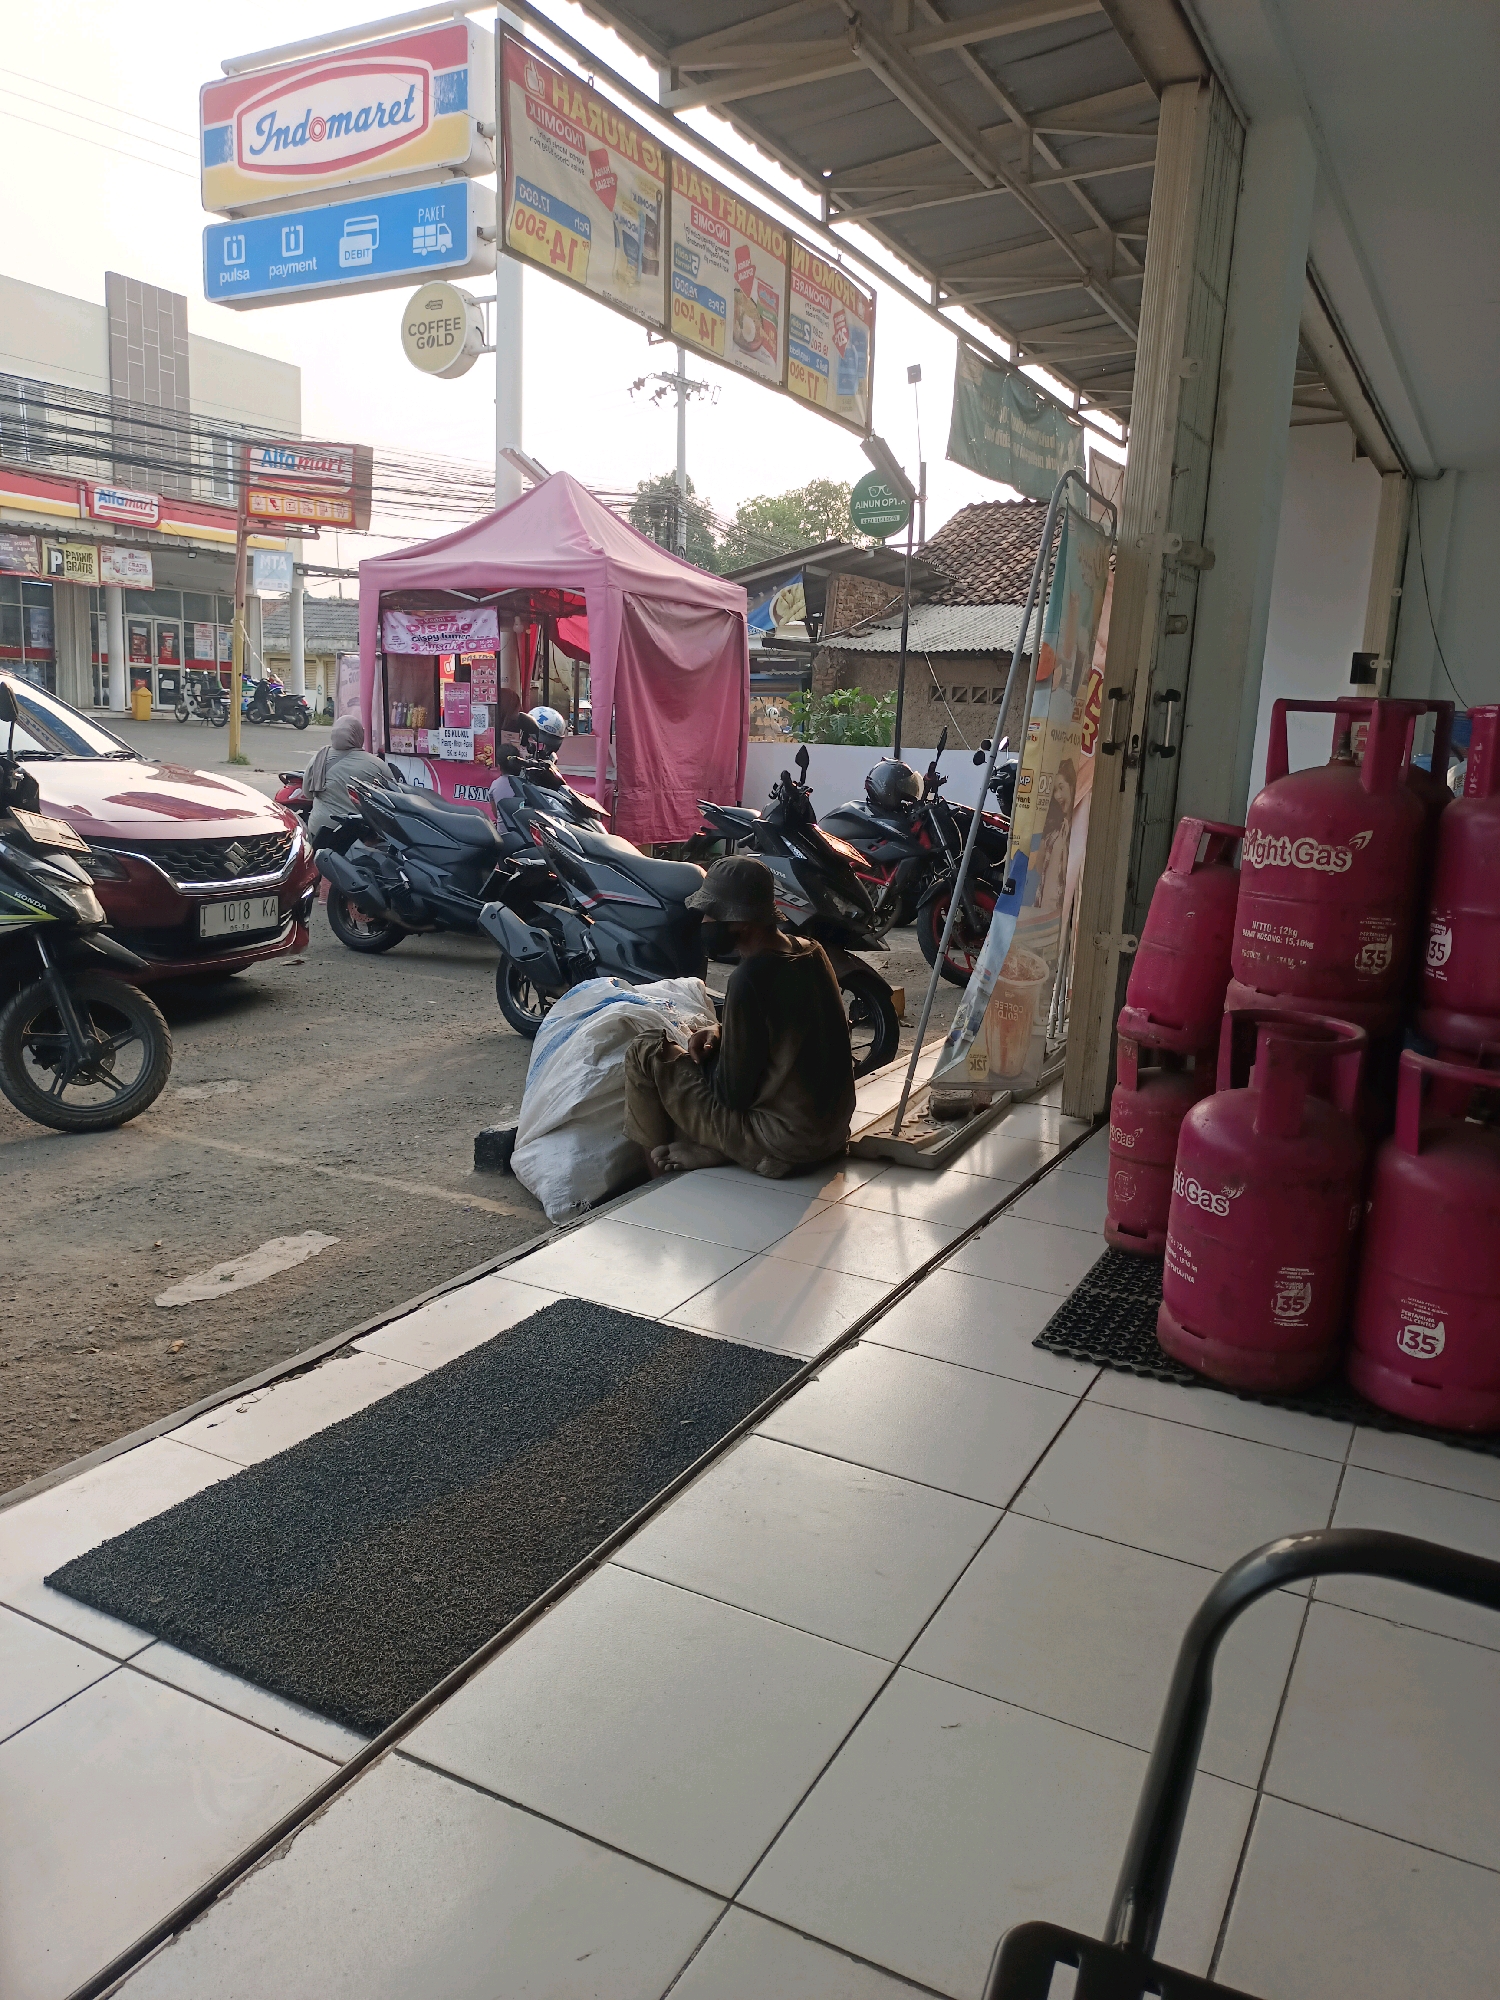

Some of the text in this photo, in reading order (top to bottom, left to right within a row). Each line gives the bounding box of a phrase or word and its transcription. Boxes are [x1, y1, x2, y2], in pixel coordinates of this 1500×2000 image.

[249, 84, 416, 156] Indomaret
[418, 204, 445, 223] PAKET
[344, 247, 371, 261] DEBIT
[219, 266, 250, 286] pulsa
[268, 256, 318, 280] payment
[408, 316, 461, 337] COFFEE
[416, 333, 454, 350] GOLD
[261, 448, 346, 475] Alfamart
[98, 489, 156, 513] Alfamart
[854, 499, 881, 510] AINUN
[51, 550, 63, 573] P
[66, 560, 94, 575] GRATIS
[259, 554, 288, 571] MTA
[1294, 838, 1353, 873] Gas
[14, 891, 47, 911] HONDA
[201, 898, 277, 926] T 1018 KA
[1115, 1127, 1135, 1148] Gas
[1185, 1177, 1230, 1217] Gas
[1400, 1308, 1436, 1324] PERTAMINA
